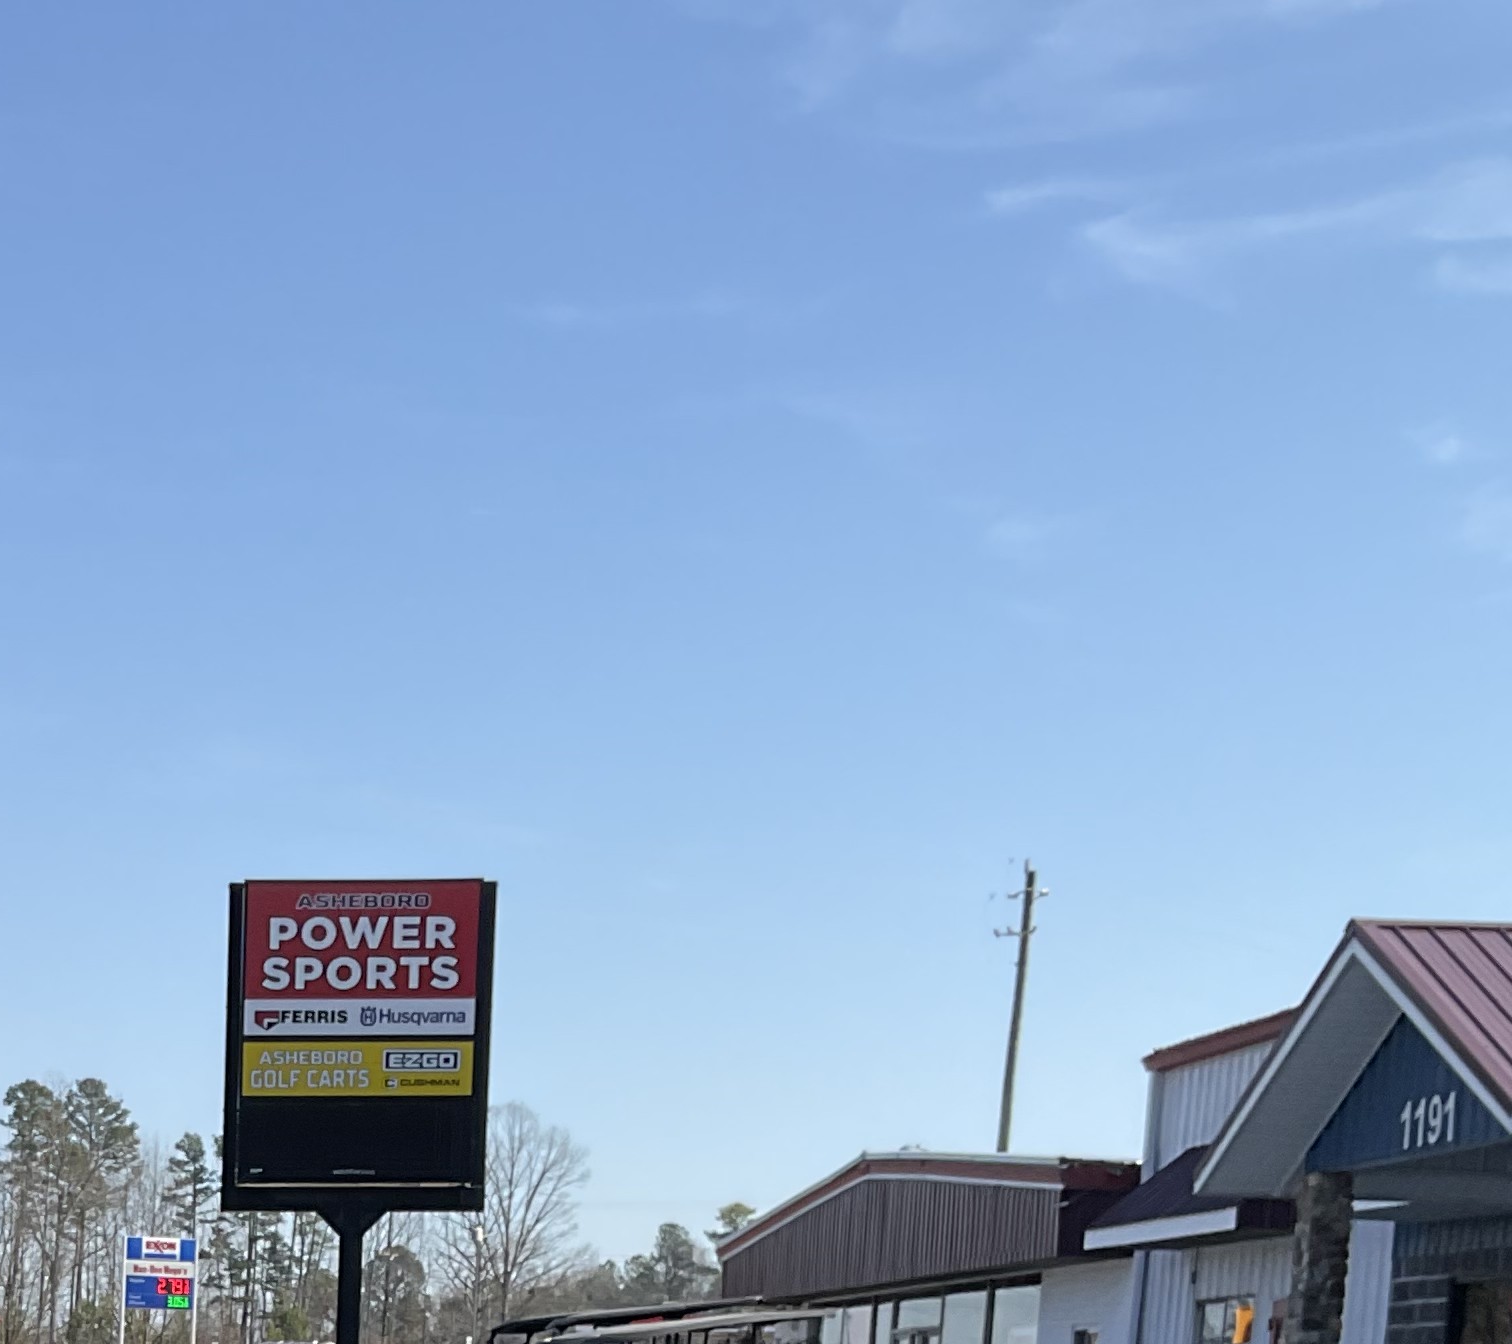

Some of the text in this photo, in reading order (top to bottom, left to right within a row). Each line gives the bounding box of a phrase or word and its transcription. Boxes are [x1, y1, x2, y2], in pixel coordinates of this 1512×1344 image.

[296, 892, 431, 910] ASHEBORO
[268, 915, 457, 951] POWER
[261, 955, 460, 991] SPORTS
[280, 1009, 349, 1024] FERRIS
[378, 1007, 466, 1026] Husqvarna
[258, 1049, 363, 1065] ASHEBORO
[387, 1052, 456, 1070] EZGO
[250, 1069, 369, 1089] GOLF CARTS
[400, 1078, 461, 1087] CUSHMAN
[1399, 1090, 1457, 1151] 1191
[145, 1240, 177, 1253] EXXON
